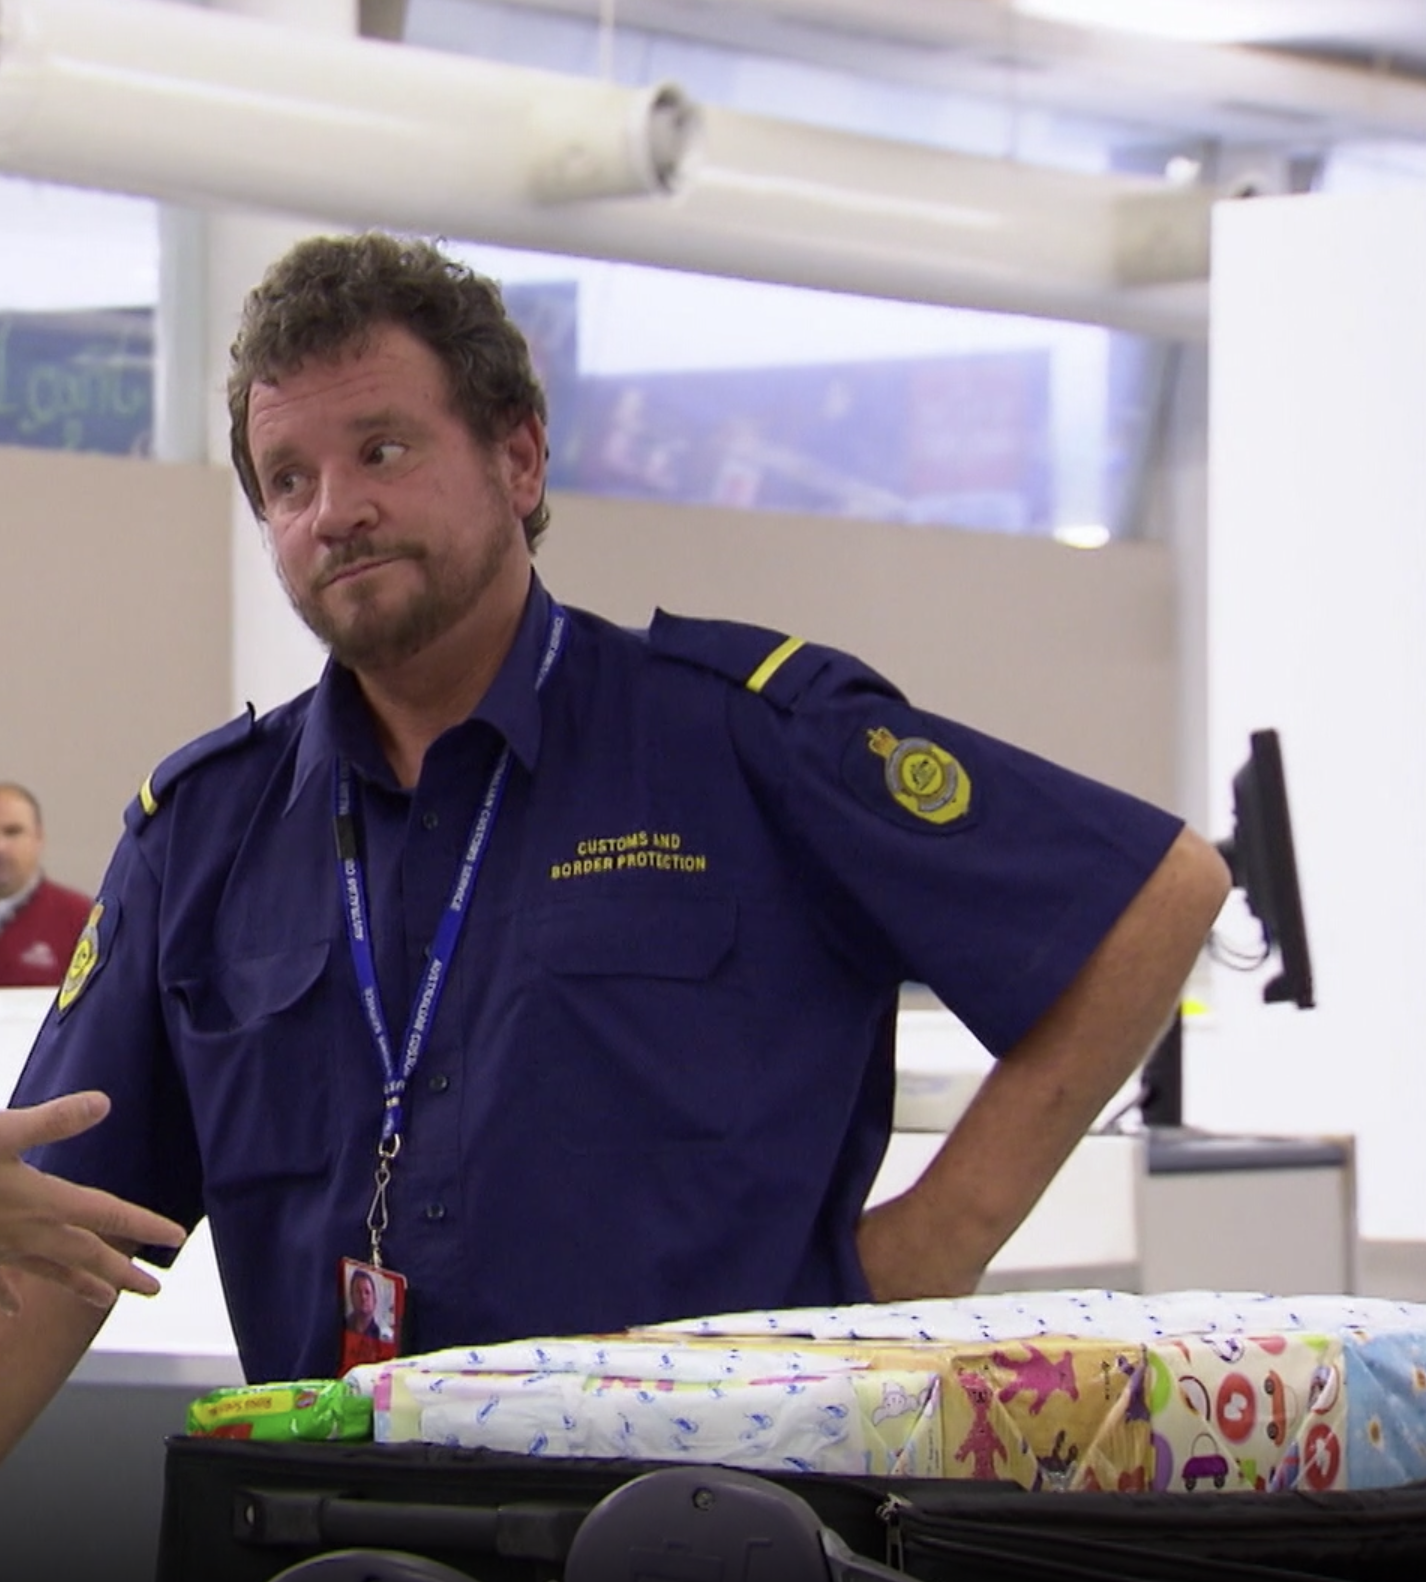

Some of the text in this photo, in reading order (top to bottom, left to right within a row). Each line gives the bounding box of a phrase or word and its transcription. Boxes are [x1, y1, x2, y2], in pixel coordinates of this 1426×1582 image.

[577, 831, 681, 856] CUSTOMS AND
[550, 851, 707, 880] BORDER PROTECTION
